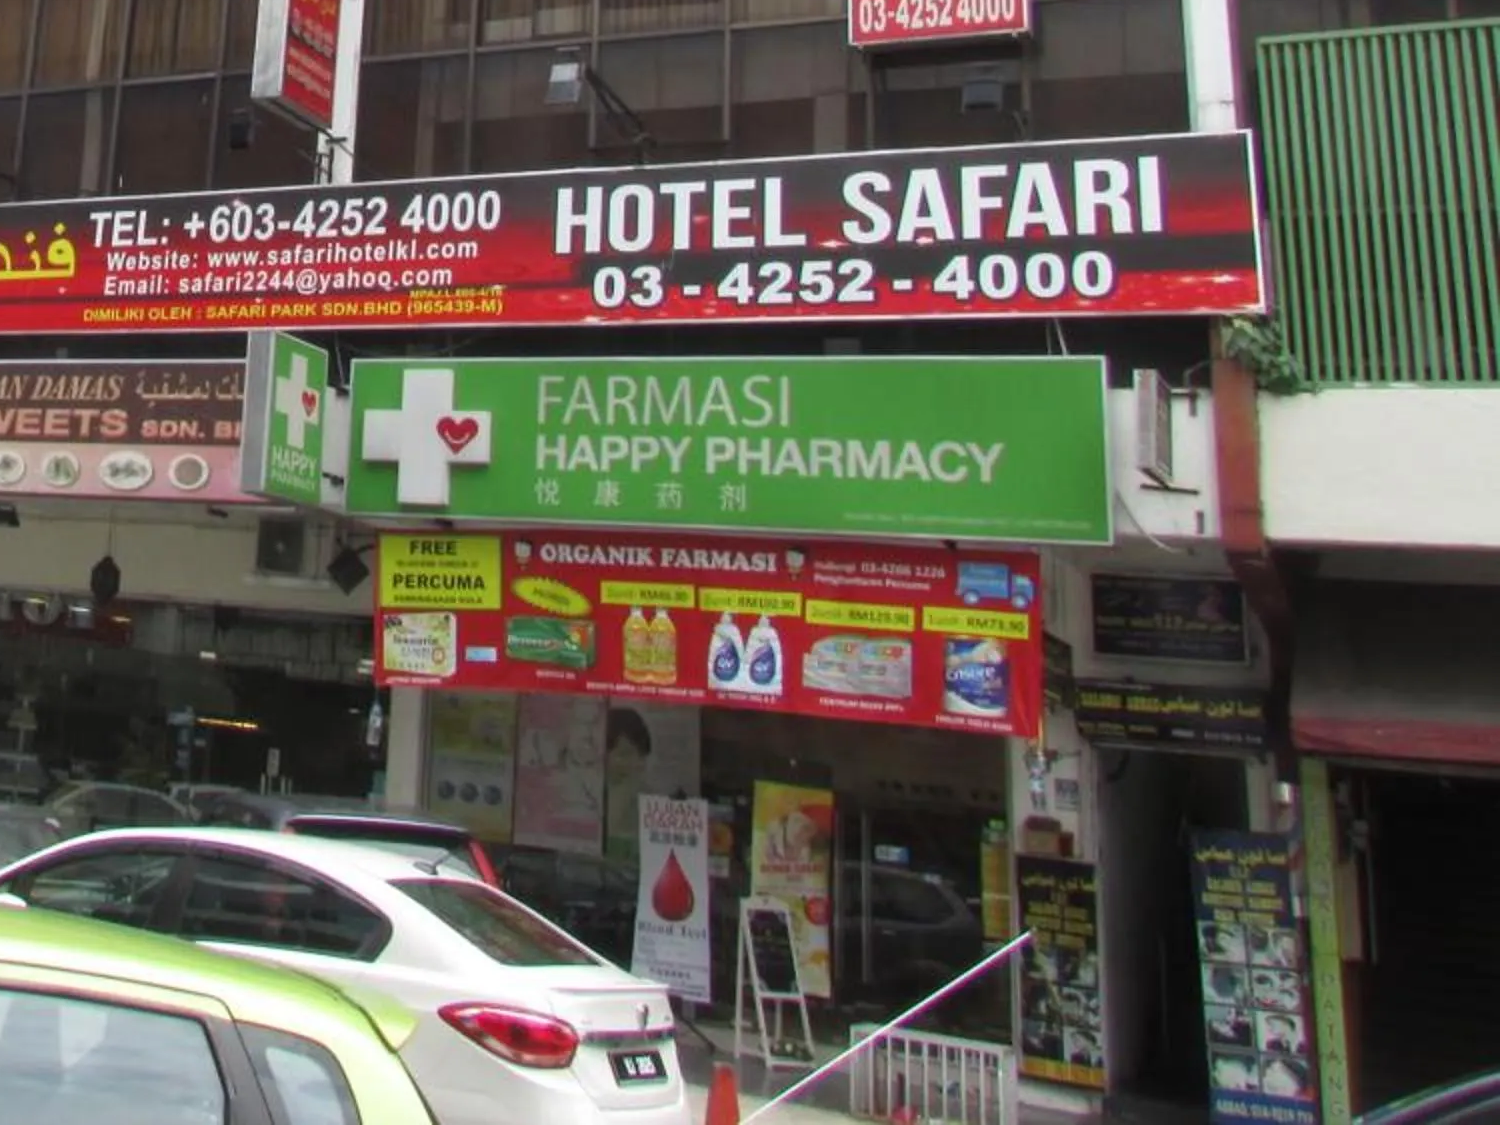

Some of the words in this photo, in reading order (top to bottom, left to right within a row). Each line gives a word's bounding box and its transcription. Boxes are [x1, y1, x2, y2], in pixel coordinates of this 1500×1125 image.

[90, 210, 169, 248] TEL:
[183, 195, 388, 243] +603-4252
[400, 190, 501, 232] 4000
[555, 179, 807, 253] HOTEL
[842, 155, 1163, 243] SAFARI
[105, 247, 199, 271] Website:
[206, 238, 479, 268] www.safarihotelkl.com
[103, 274, 170, 296] Email:
[147, 305, 193, 321] OLEH
[206, 303, 267, 320] SAFARI
[270, 301, 318, 317] PARK
[28, 375, 125, 401] DAMAS
[536, 375, 791, 428] FARMASI
[141, 419, 205, 439] SDN.
[271, 445, 317, 477] HAPPY
[535, 436, 692, 473] HAPPY
[705, 439, 1003, 483] PHARMACY
[409, 539, 457, 557] FREE
[539, 542, 655, 568] ORGANIK
[660, 547, 778, 573] FARMASI
[392, 573, 486, 591] PERCUMA
